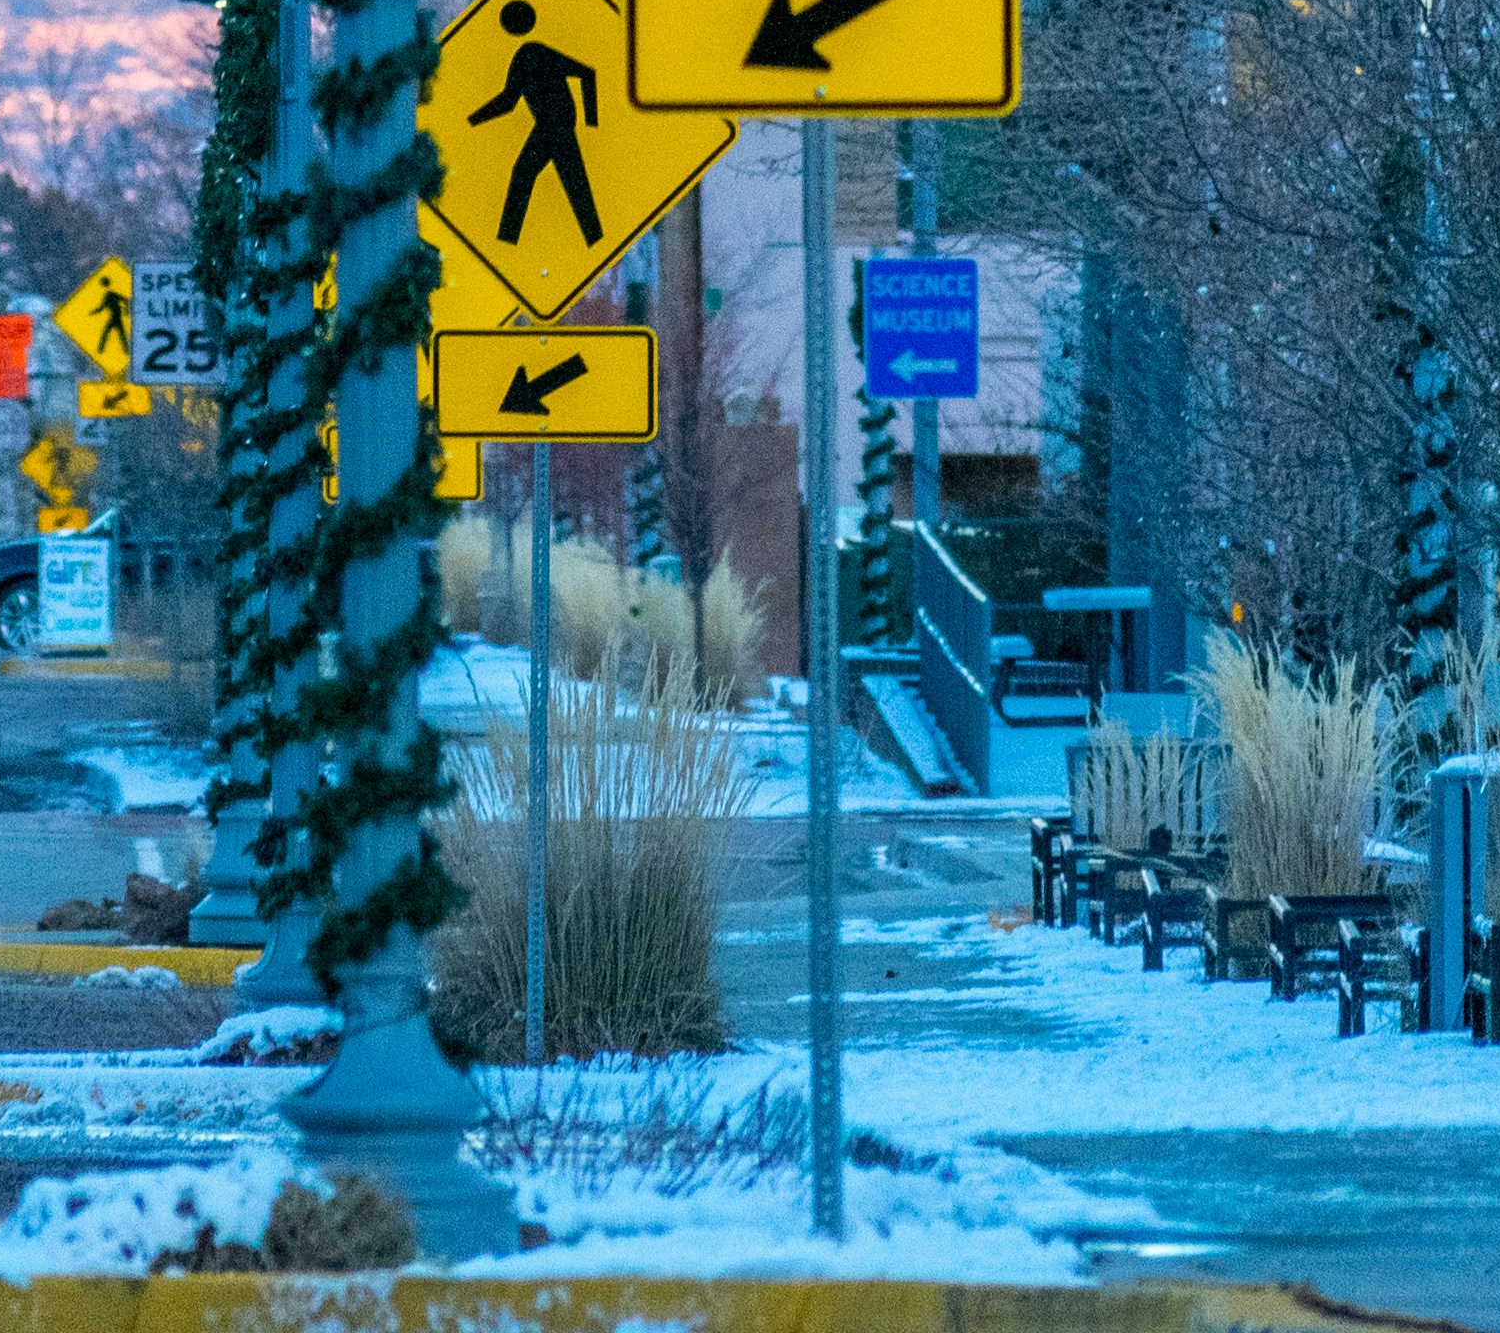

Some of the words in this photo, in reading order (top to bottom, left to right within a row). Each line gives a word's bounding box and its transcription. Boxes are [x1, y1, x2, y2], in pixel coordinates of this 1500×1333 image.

[871, 274, 974, 298] SCIENCE
[147, 299, 200, 317] LIMI
[871, 309, 972, 332] MUSEUM
[144, 328, 218, 372] 25
